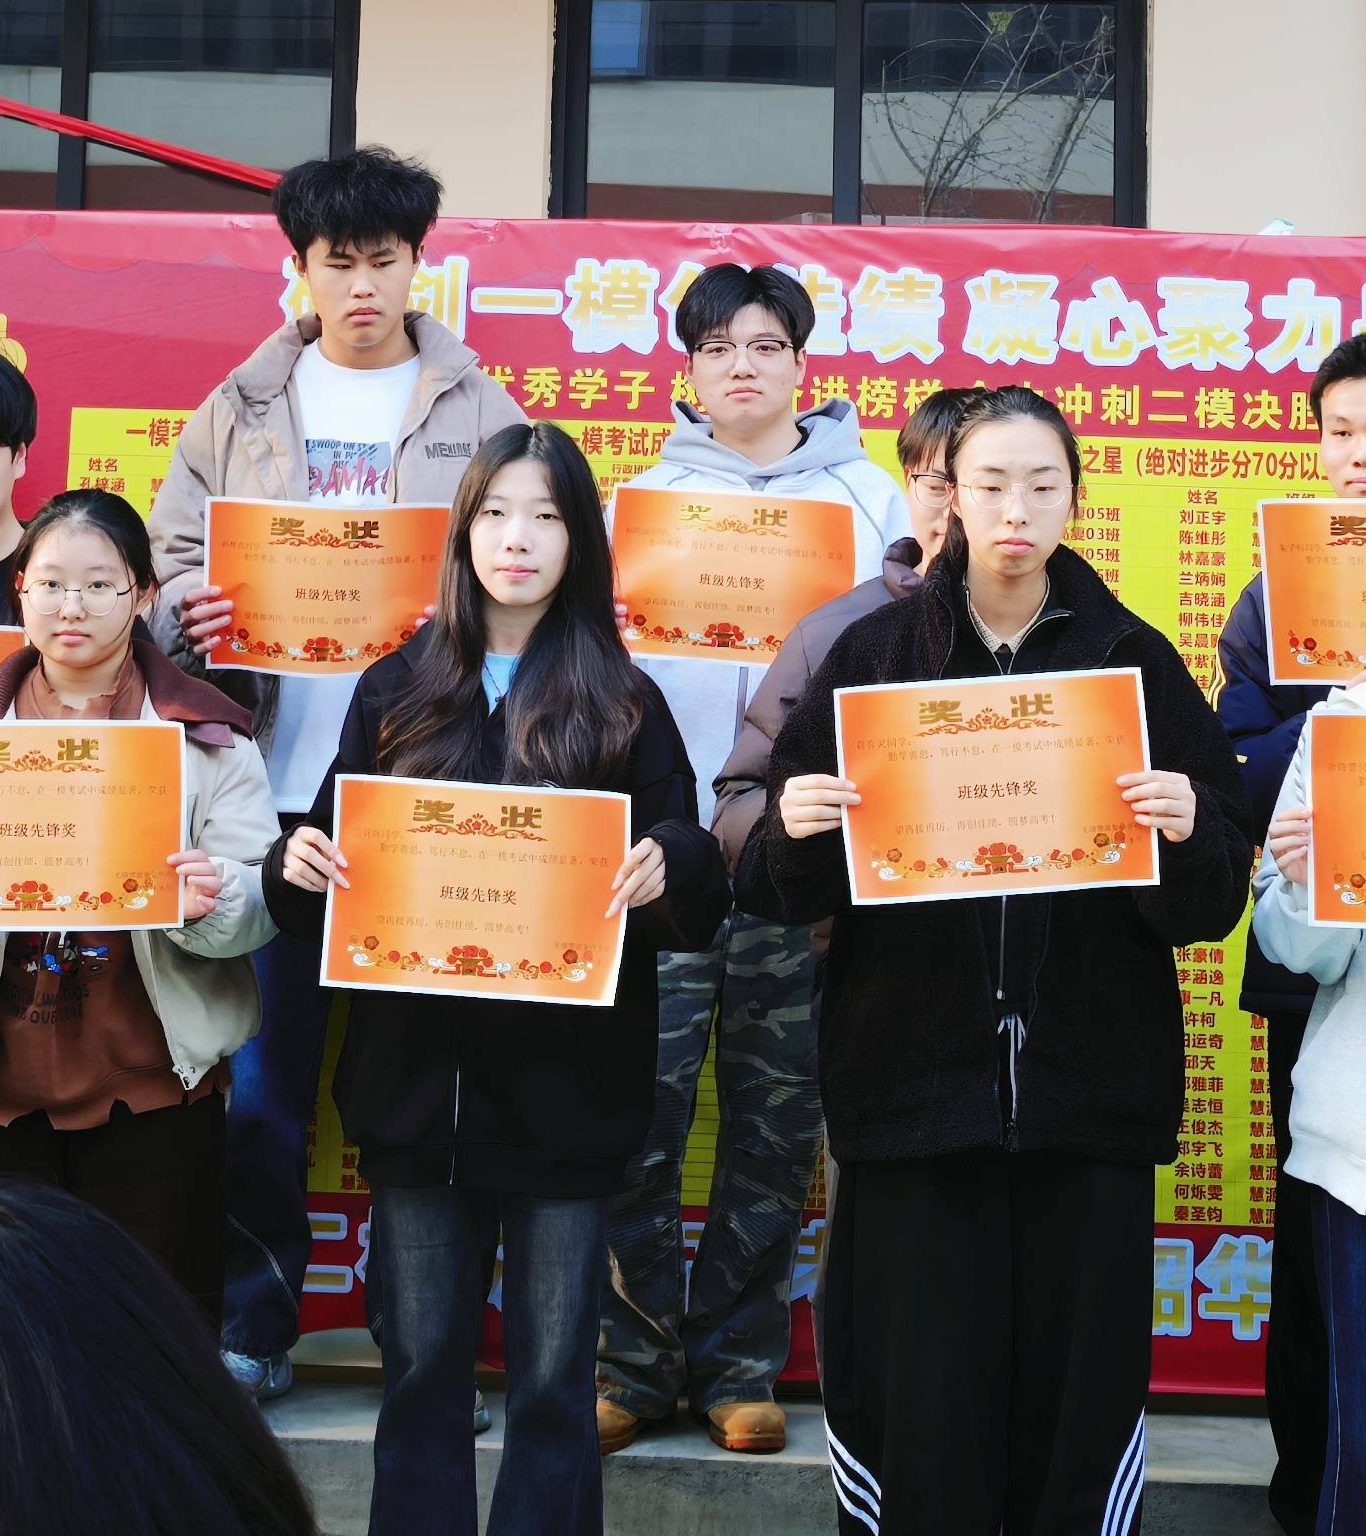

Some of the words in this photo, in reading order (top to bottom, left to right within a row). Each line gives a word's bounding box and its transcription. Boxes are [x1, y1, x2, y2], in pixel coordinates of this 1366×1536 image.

[89, 457, 118, 472] 姓名
[1187, 490, 1218, 504] 姓名
[1179, 510, 1226, 525] 刘正宇
[699, 573, 766, 591] 班级先锋奖
[295, 588, 362, 602] 班级先锋奖
[1179, 592, 1225, 608] 吉晓涵
[957, 780, 1038, 800] 班级先锋奖
[439, 886, 517, 905] 班级先锋奖
[1185, 1012, 1216, 1028] 许柯
